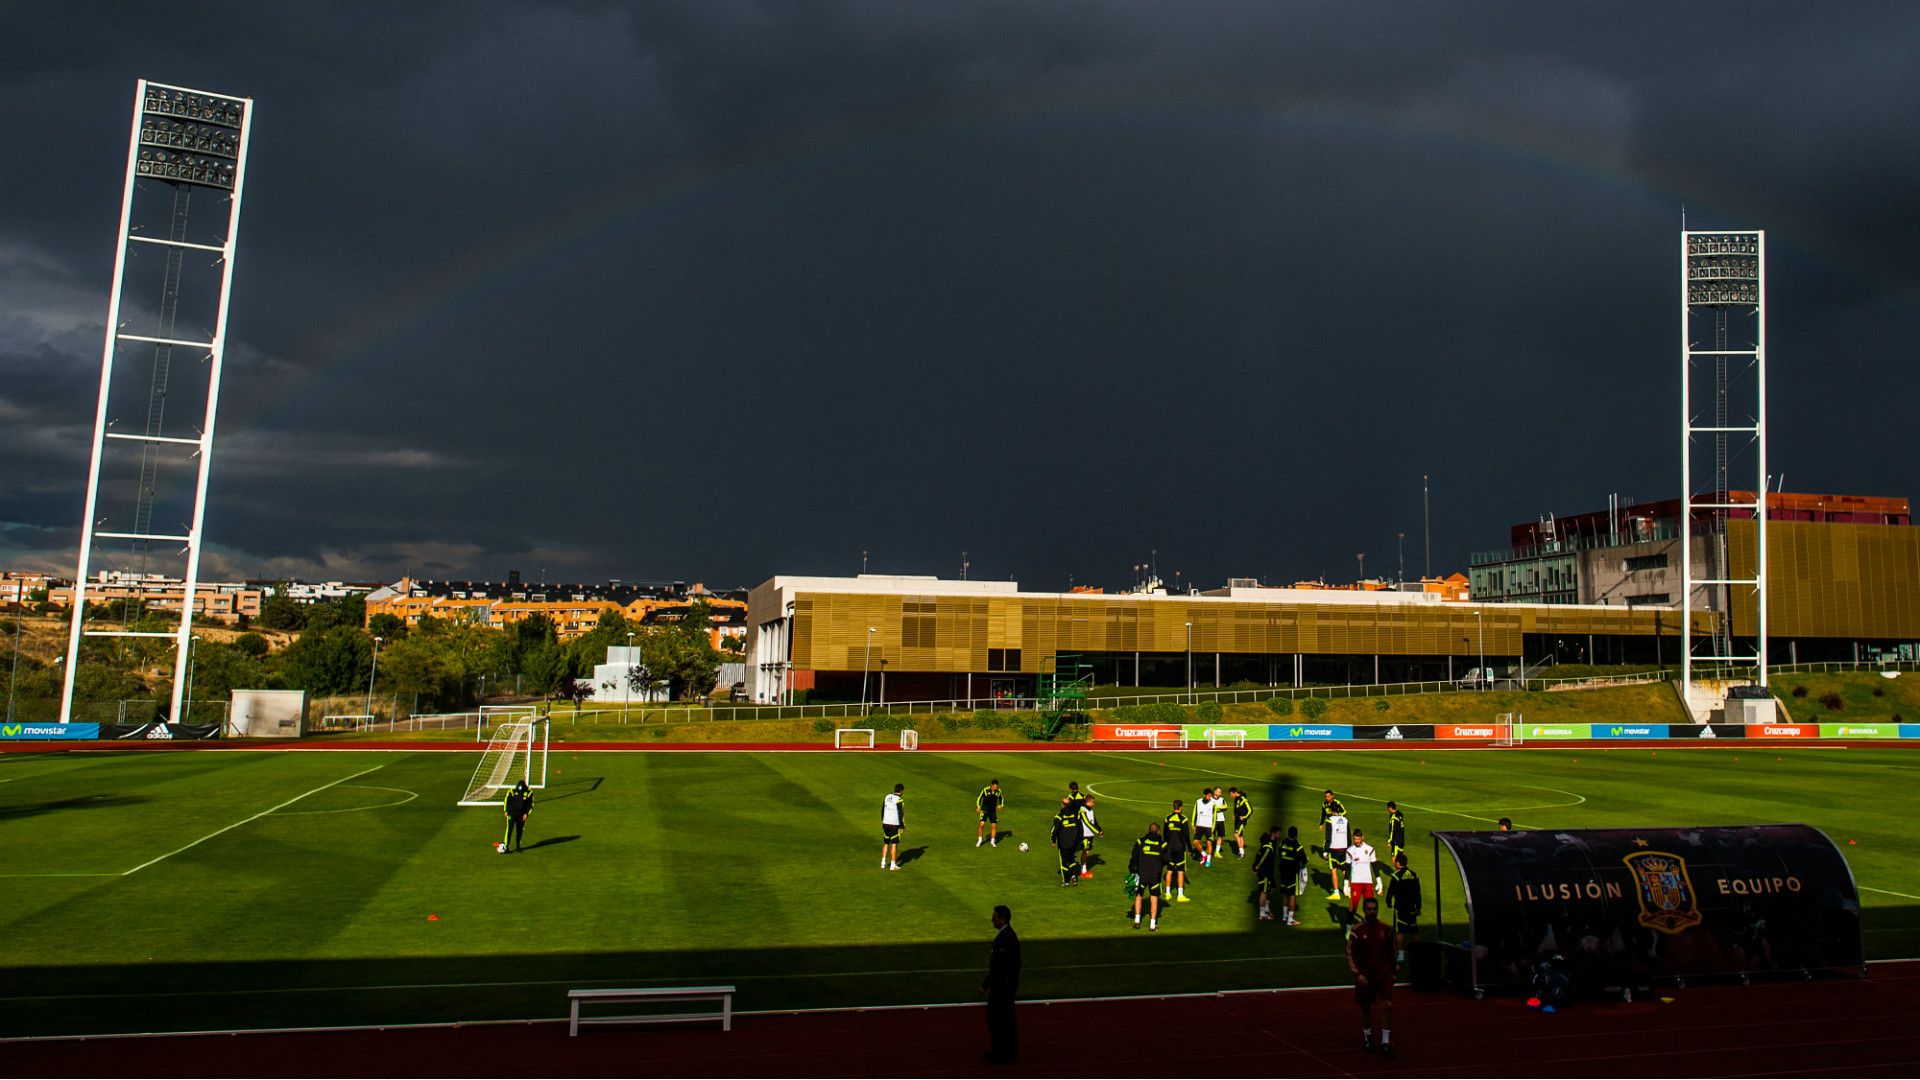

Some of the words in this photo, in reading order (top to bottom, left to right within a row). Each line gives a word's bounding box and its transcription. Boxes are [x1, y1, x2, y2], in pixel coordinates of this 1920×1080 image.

[24, 727, 67, 735] movistar
[147, 731, 173, 740] adidas
[1454, 727, 1494, 738] Cruzcampo
[1764, 726, 1801, 737] Cruzcampo
[1515, 879, 1623, 902] ILUSIÓN
[1717, 875, 1802, 896] EQUIPO
